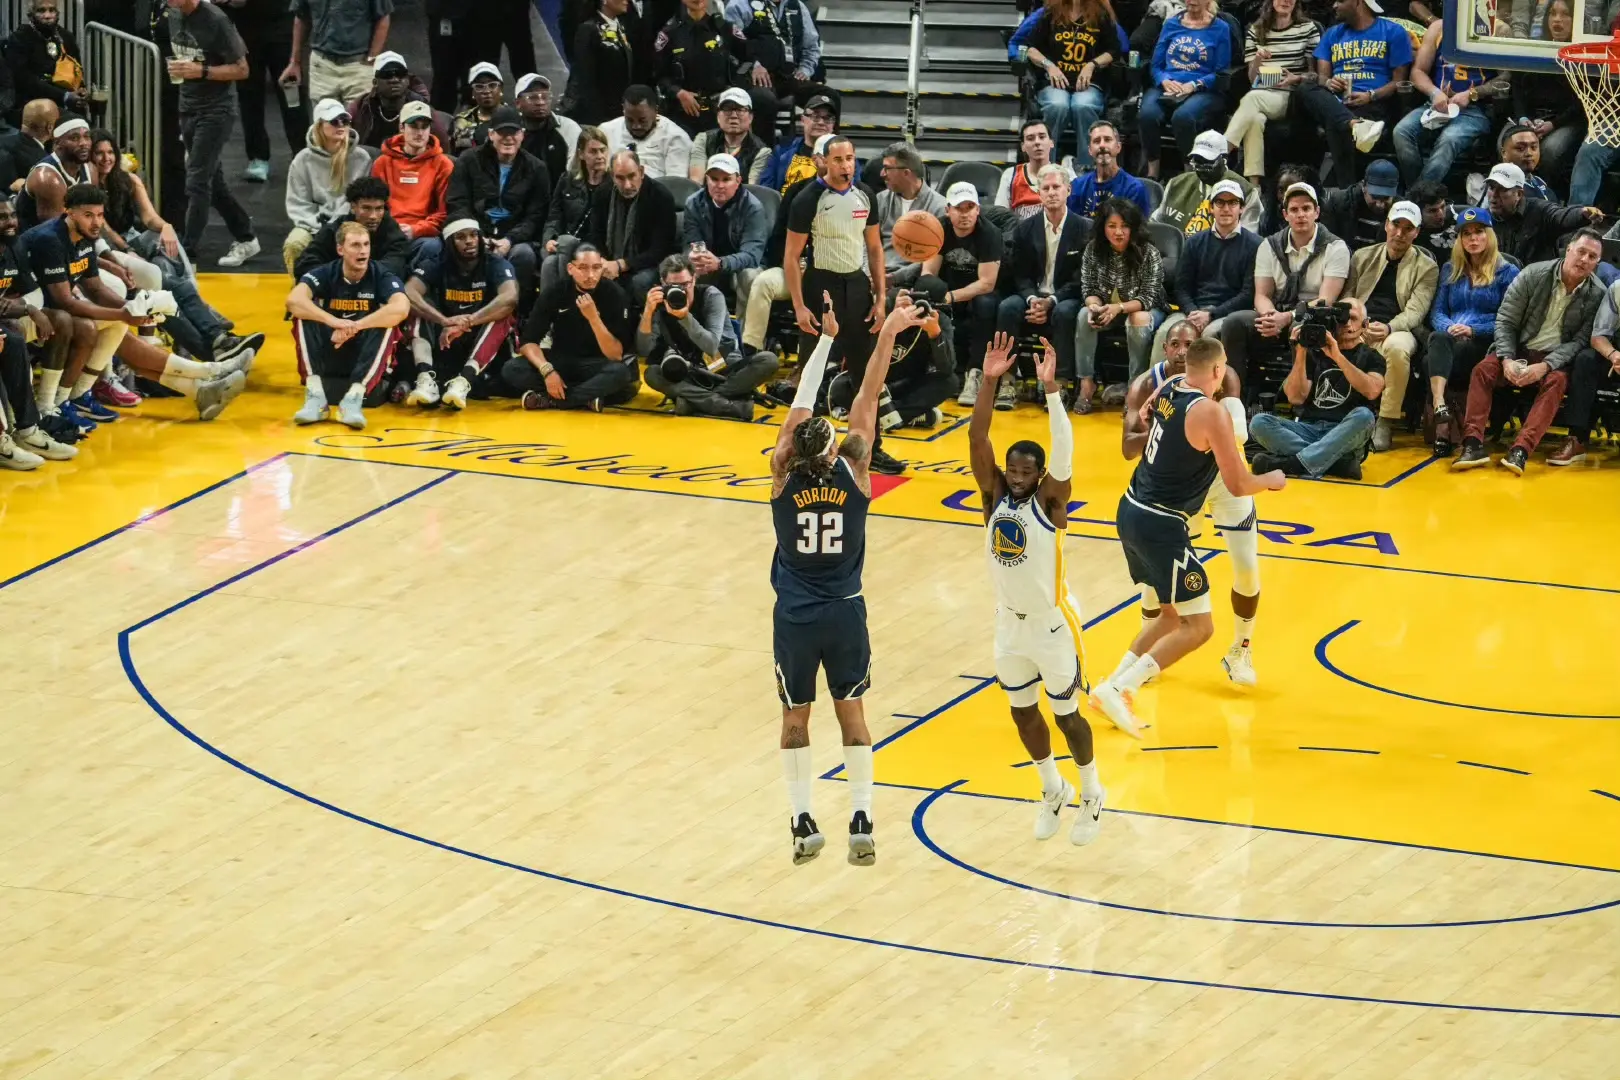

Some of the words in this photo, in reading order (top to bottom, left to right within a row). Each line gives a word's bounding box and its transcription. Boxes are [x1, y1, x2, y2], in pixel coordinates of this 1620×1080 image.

[1062, 41, 1086, 62] 30
[1194, 38, 1208, 61] STATE
[330, 299, 369, 311] NUGGETS
[793, 487, 848, 508] GORDON
[797, 511, 843, 554] 32
